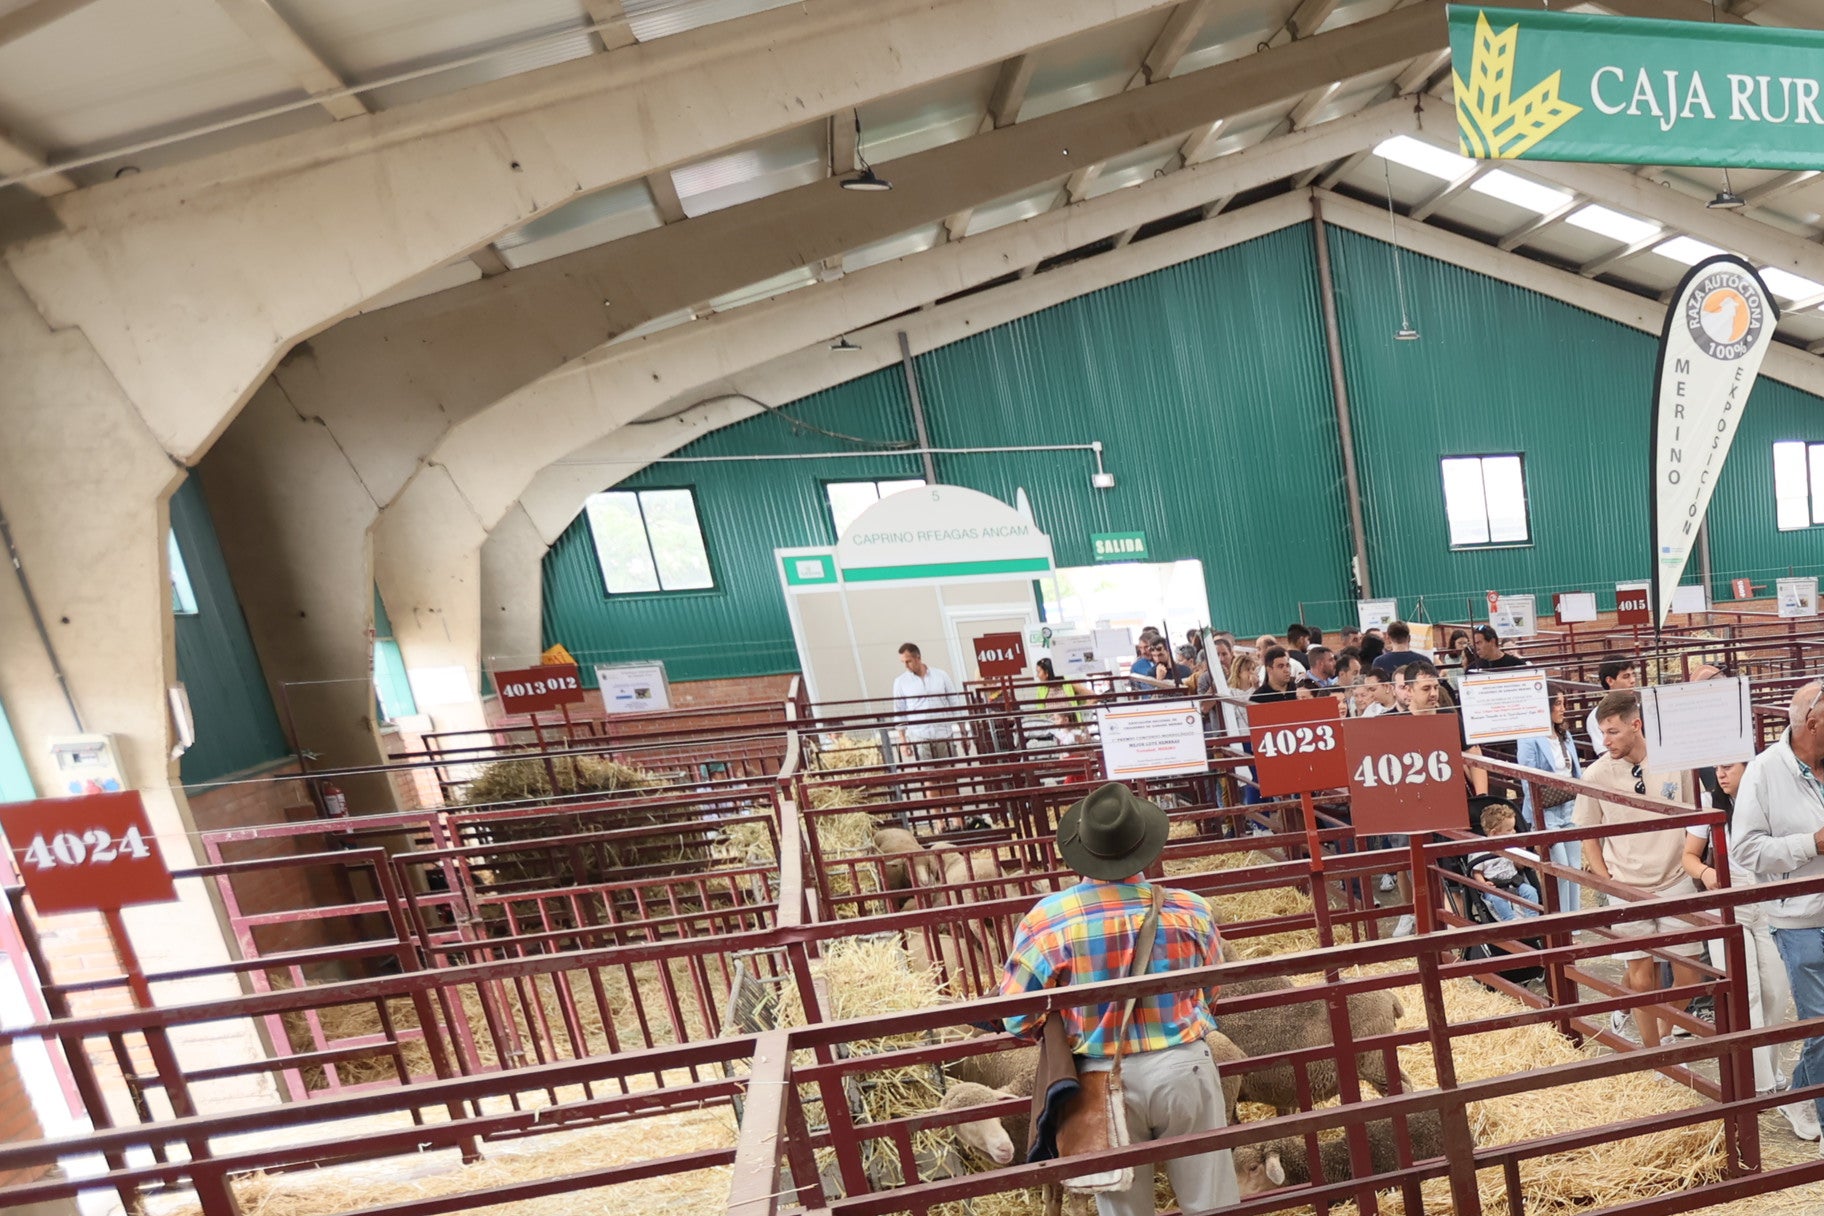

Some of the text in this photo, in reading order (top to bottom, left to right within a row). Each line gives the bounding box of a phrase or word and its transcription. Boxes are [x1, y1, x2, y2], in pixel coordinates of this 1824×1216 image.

[1590, 66, 1716, 132] CAJA
[1688, 274, 1762, 329] RAZA AUTÓCTONA
[1708, 342, 1748, 359] 100%
[1668, 358, 1690, 485] MERINO
[1682, 367, 1744, 535] EXPOSICIÓN
[932, 490, 940, 502] 5
[852, 531, 914, 546] CAPRINO
[982, 525, 1029, 539] ANCAM
[1095, 538, 1144, 554] SALIDA
[1618, 599, 1646, 612] 4015
[978, 648, 1014, 663] 4014
[503, 681, 547, 698] 4013
[547, 676, 578, 690] 012
[1257, 725, 1336, 757] 4023
[1353, 750, 1452, 787] 4026
[24, 825, 151, 869] 4024
